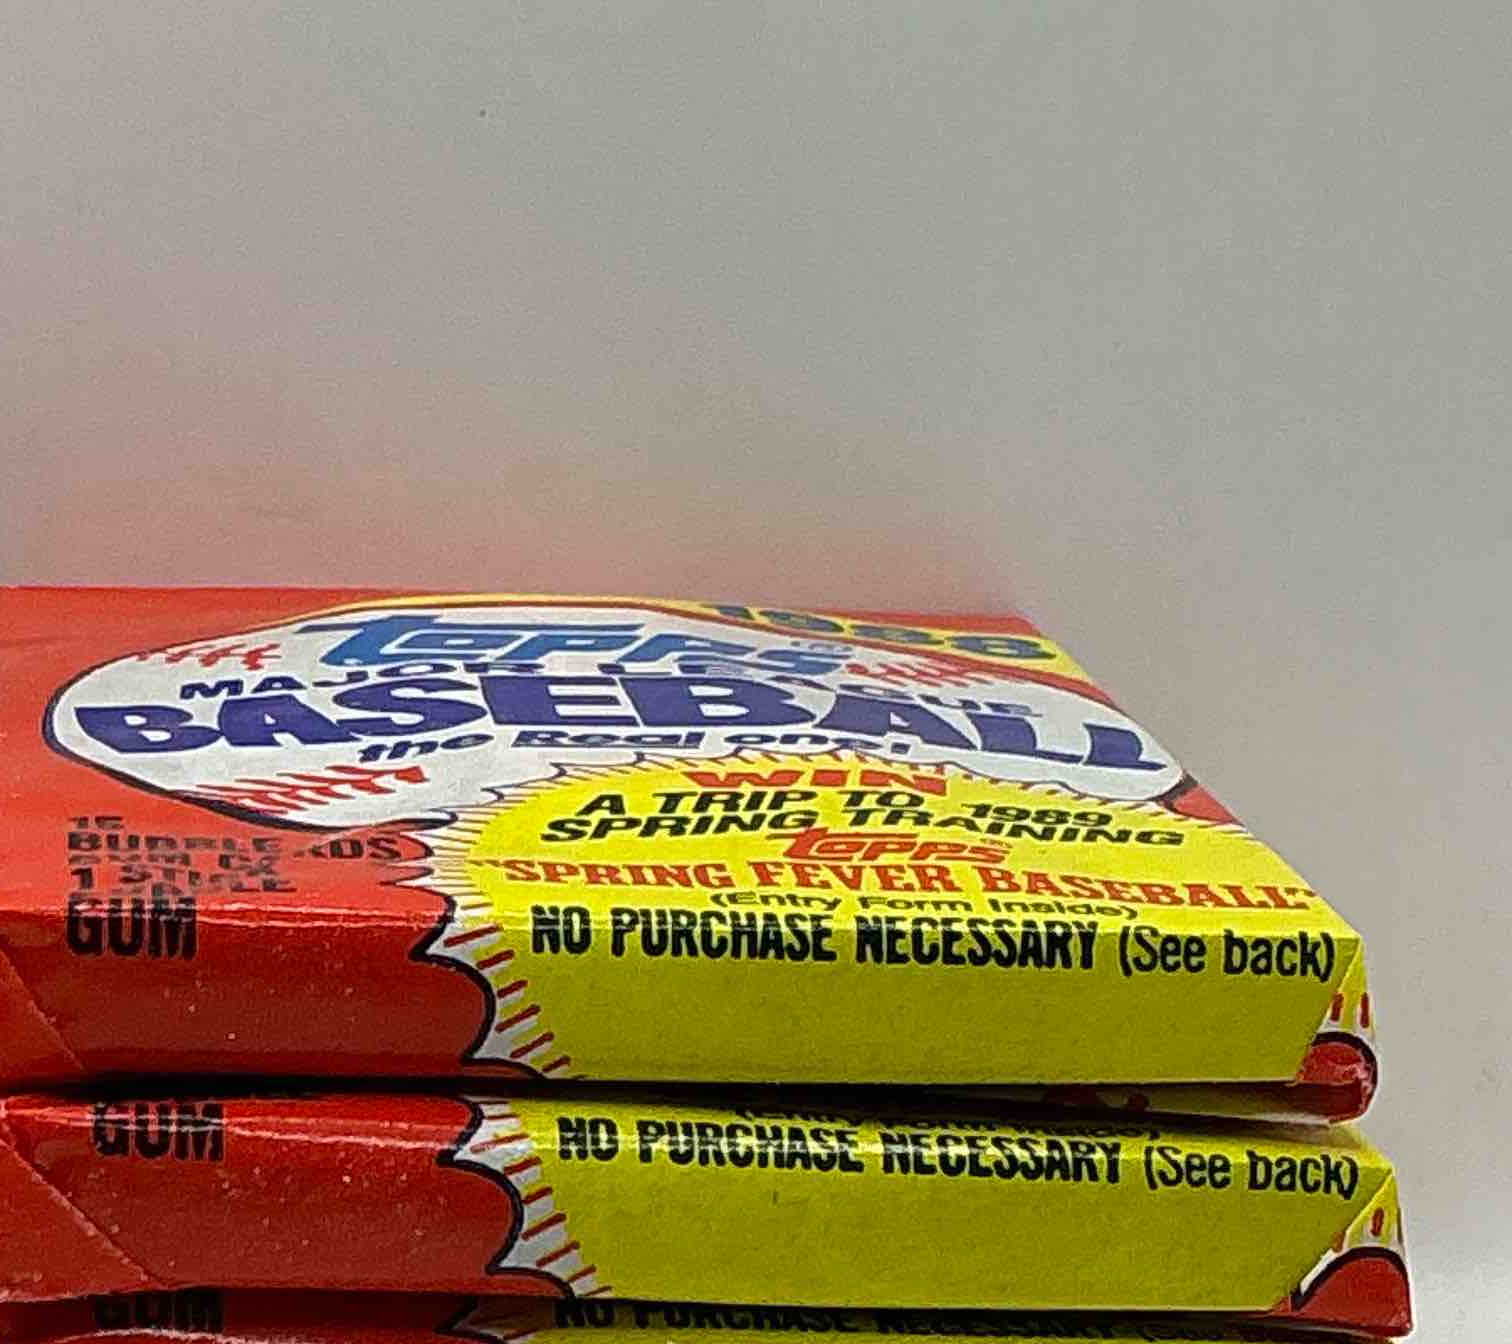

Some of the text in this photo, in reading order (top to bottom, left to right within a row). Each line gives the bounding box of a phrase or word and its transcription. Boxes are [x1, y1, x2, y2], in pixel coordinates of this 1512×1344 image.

[74, 674, 1166, 770] BASEBALL
[358, 731, 494, 763] the
[511, 730, 705, 750] Real
[683, 769, 947, 796] WIN
[540, 808, 1184, 846] SPRING TRAINING
[575, 789, 1115, 827] A TRIP TO 1989
[748, 862, 963, 892] FEVER
[857, 895, 973, 913] Form
[67, 894, 197, 957] GUM
[530, 905, 1335, 983] NO PURCHASE NECESSARY (See back)
[92, 1103, 224, 1162] GUM
[556, 1117, 619, 1161] NO
[636, 1119, 864, 1172] PURCHASE
[880, 1131, 1121, 1184] NECESSARY
[1143, 1144, 1231, 1190] (See
[1246, 1150, 1359, 1201] back)
